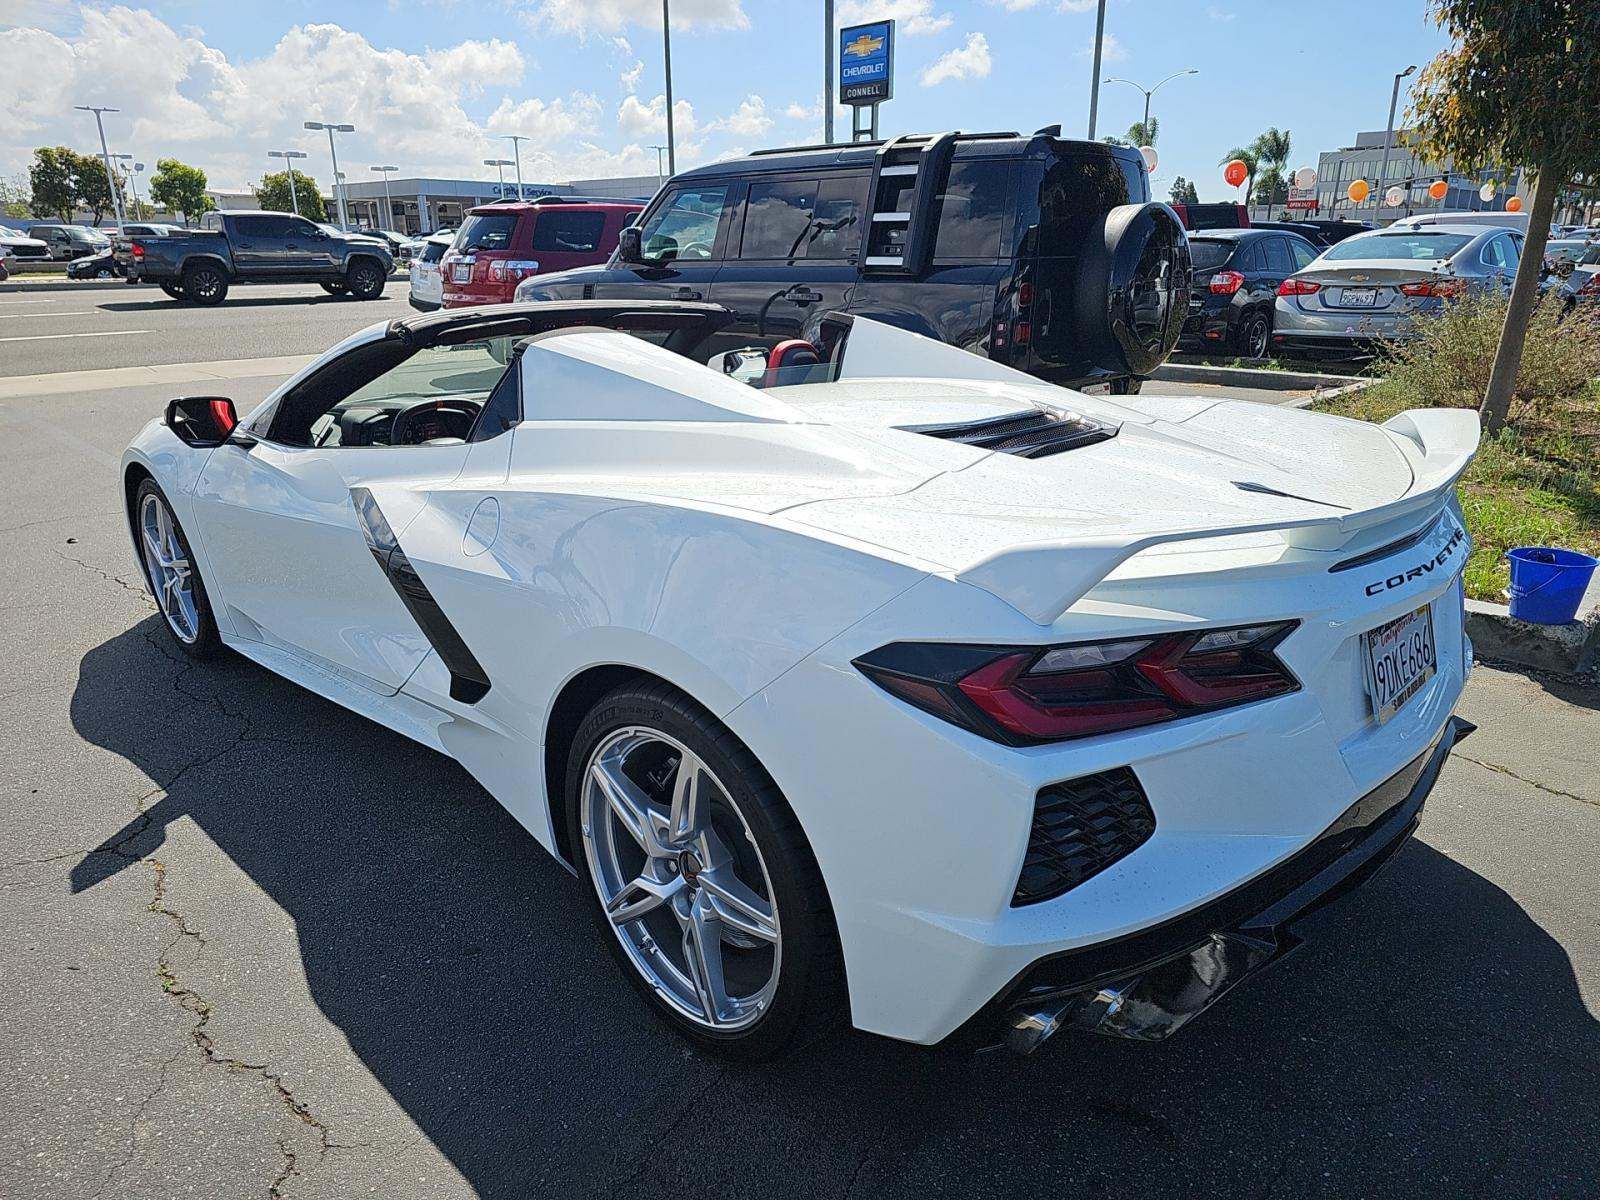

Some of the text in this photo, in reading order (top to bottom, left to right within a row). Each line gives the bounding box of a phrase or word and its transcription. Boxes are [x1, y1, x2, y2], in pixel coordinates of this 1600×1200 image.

[843, 63, 884, 77] CHEVROLET
[847, 85, 880, 98] CONNELL
[526, 188, 553, 196] Service
[1365, 528, 1464, 597] CORVETTE
[1377, 624, 1432, 706] 9DKE686
